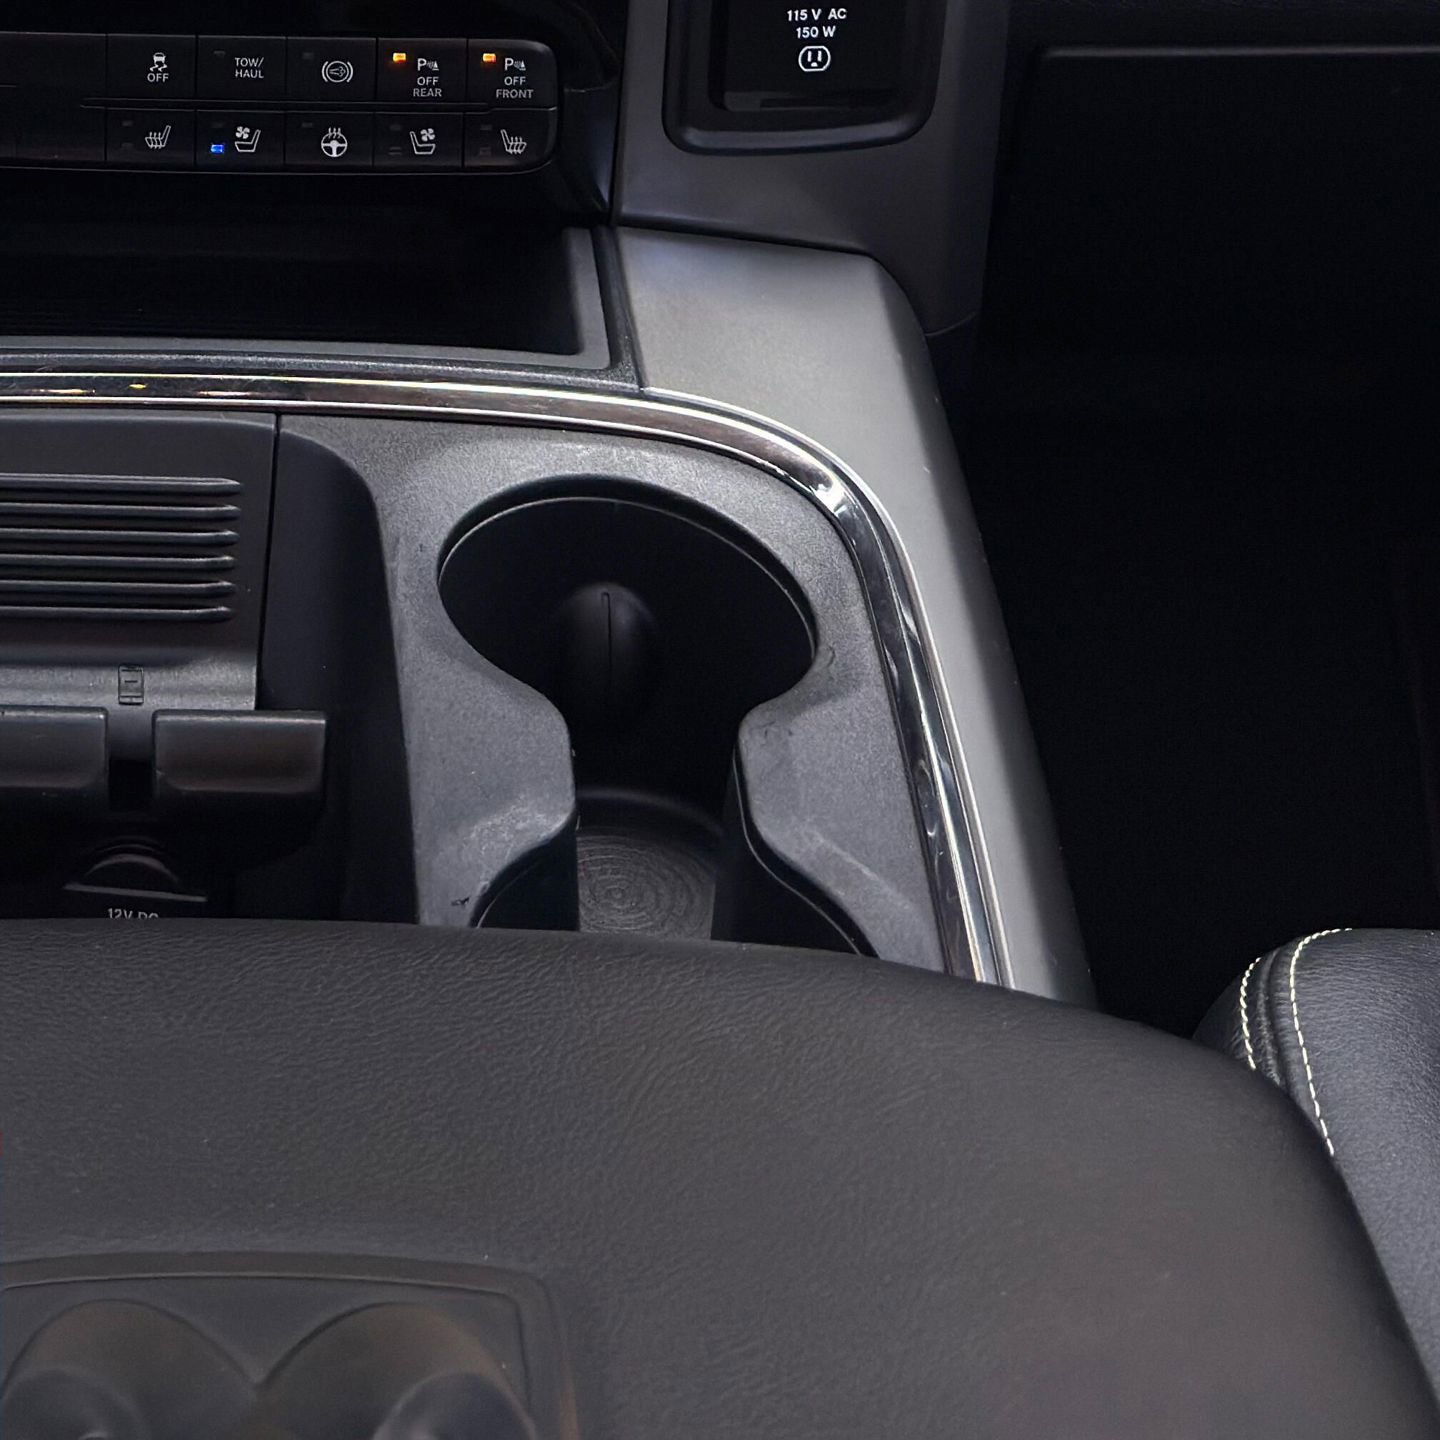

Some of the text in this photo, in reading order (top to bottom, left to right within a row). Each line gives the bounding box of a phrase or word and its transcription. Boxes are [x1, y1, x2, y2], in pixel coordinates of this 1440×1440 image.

[786, 7, 848, 22] 115 V AC
[795, 24, 837, 40] 150 W
[234, 56, 265, 69] TOW/
[146, 72, 170, 84] OFF
[234, 67, 265, 80] HAUL
[416, 75, 440, 87] OFF
[503, 75, 527, 87] OFF
[412, 87, 443, 99] REAR
[495, 87, 535, 100] FRONT
